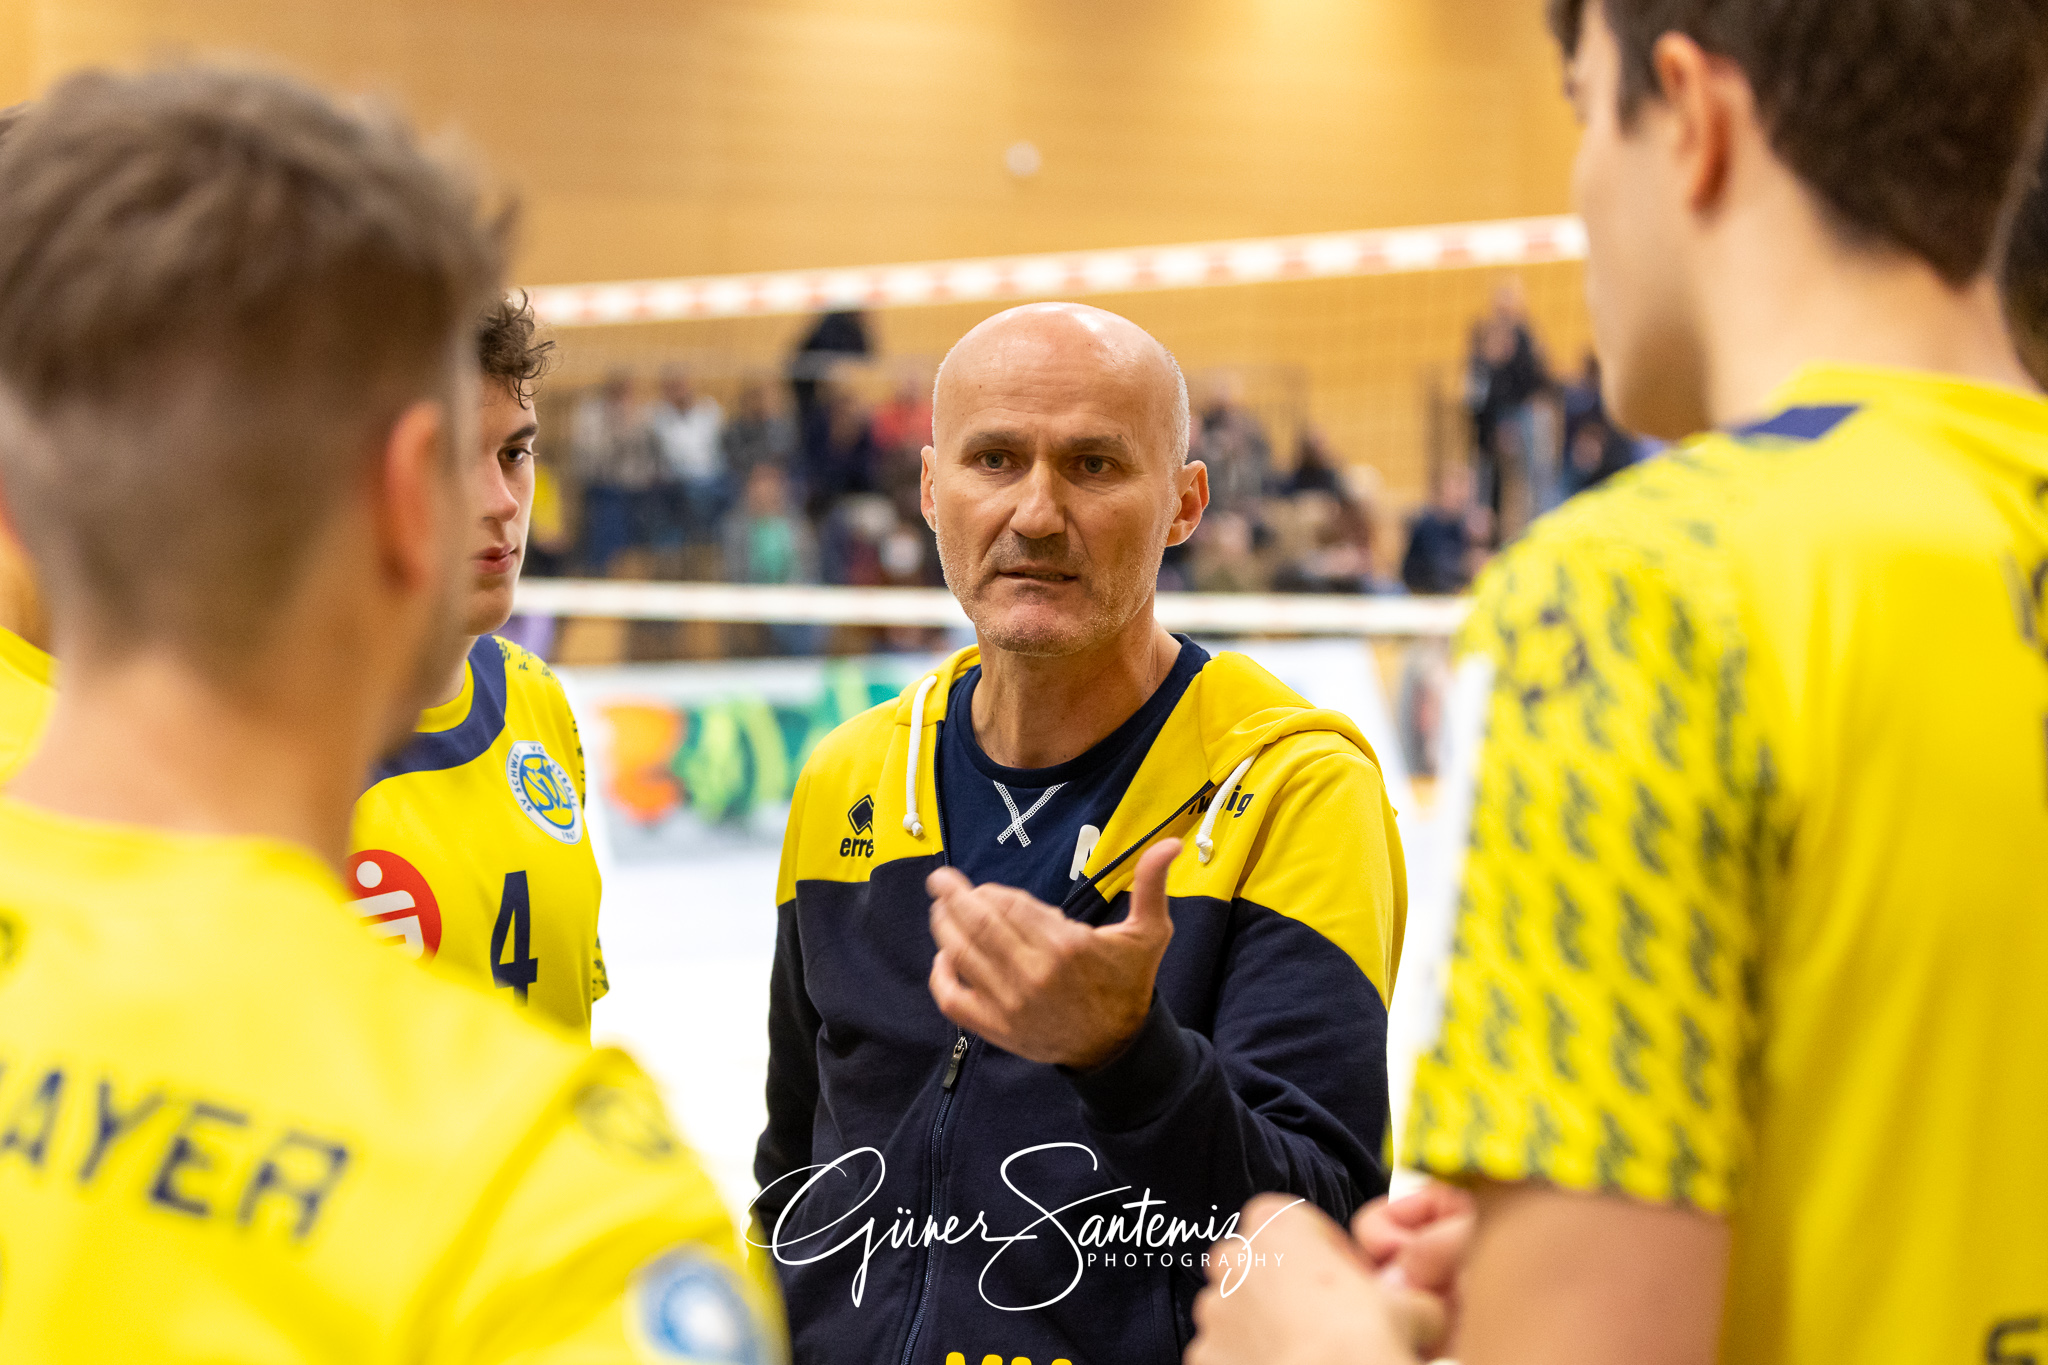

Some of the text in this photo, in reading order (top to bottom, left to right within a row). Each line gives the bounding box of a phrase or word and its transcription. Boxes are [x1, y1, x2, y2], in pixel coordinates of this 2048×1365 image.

[839, 837, 875, 858] erre
[490, 870, 539, 1007] 4
[0, 1063, 350, 1241] AYER
